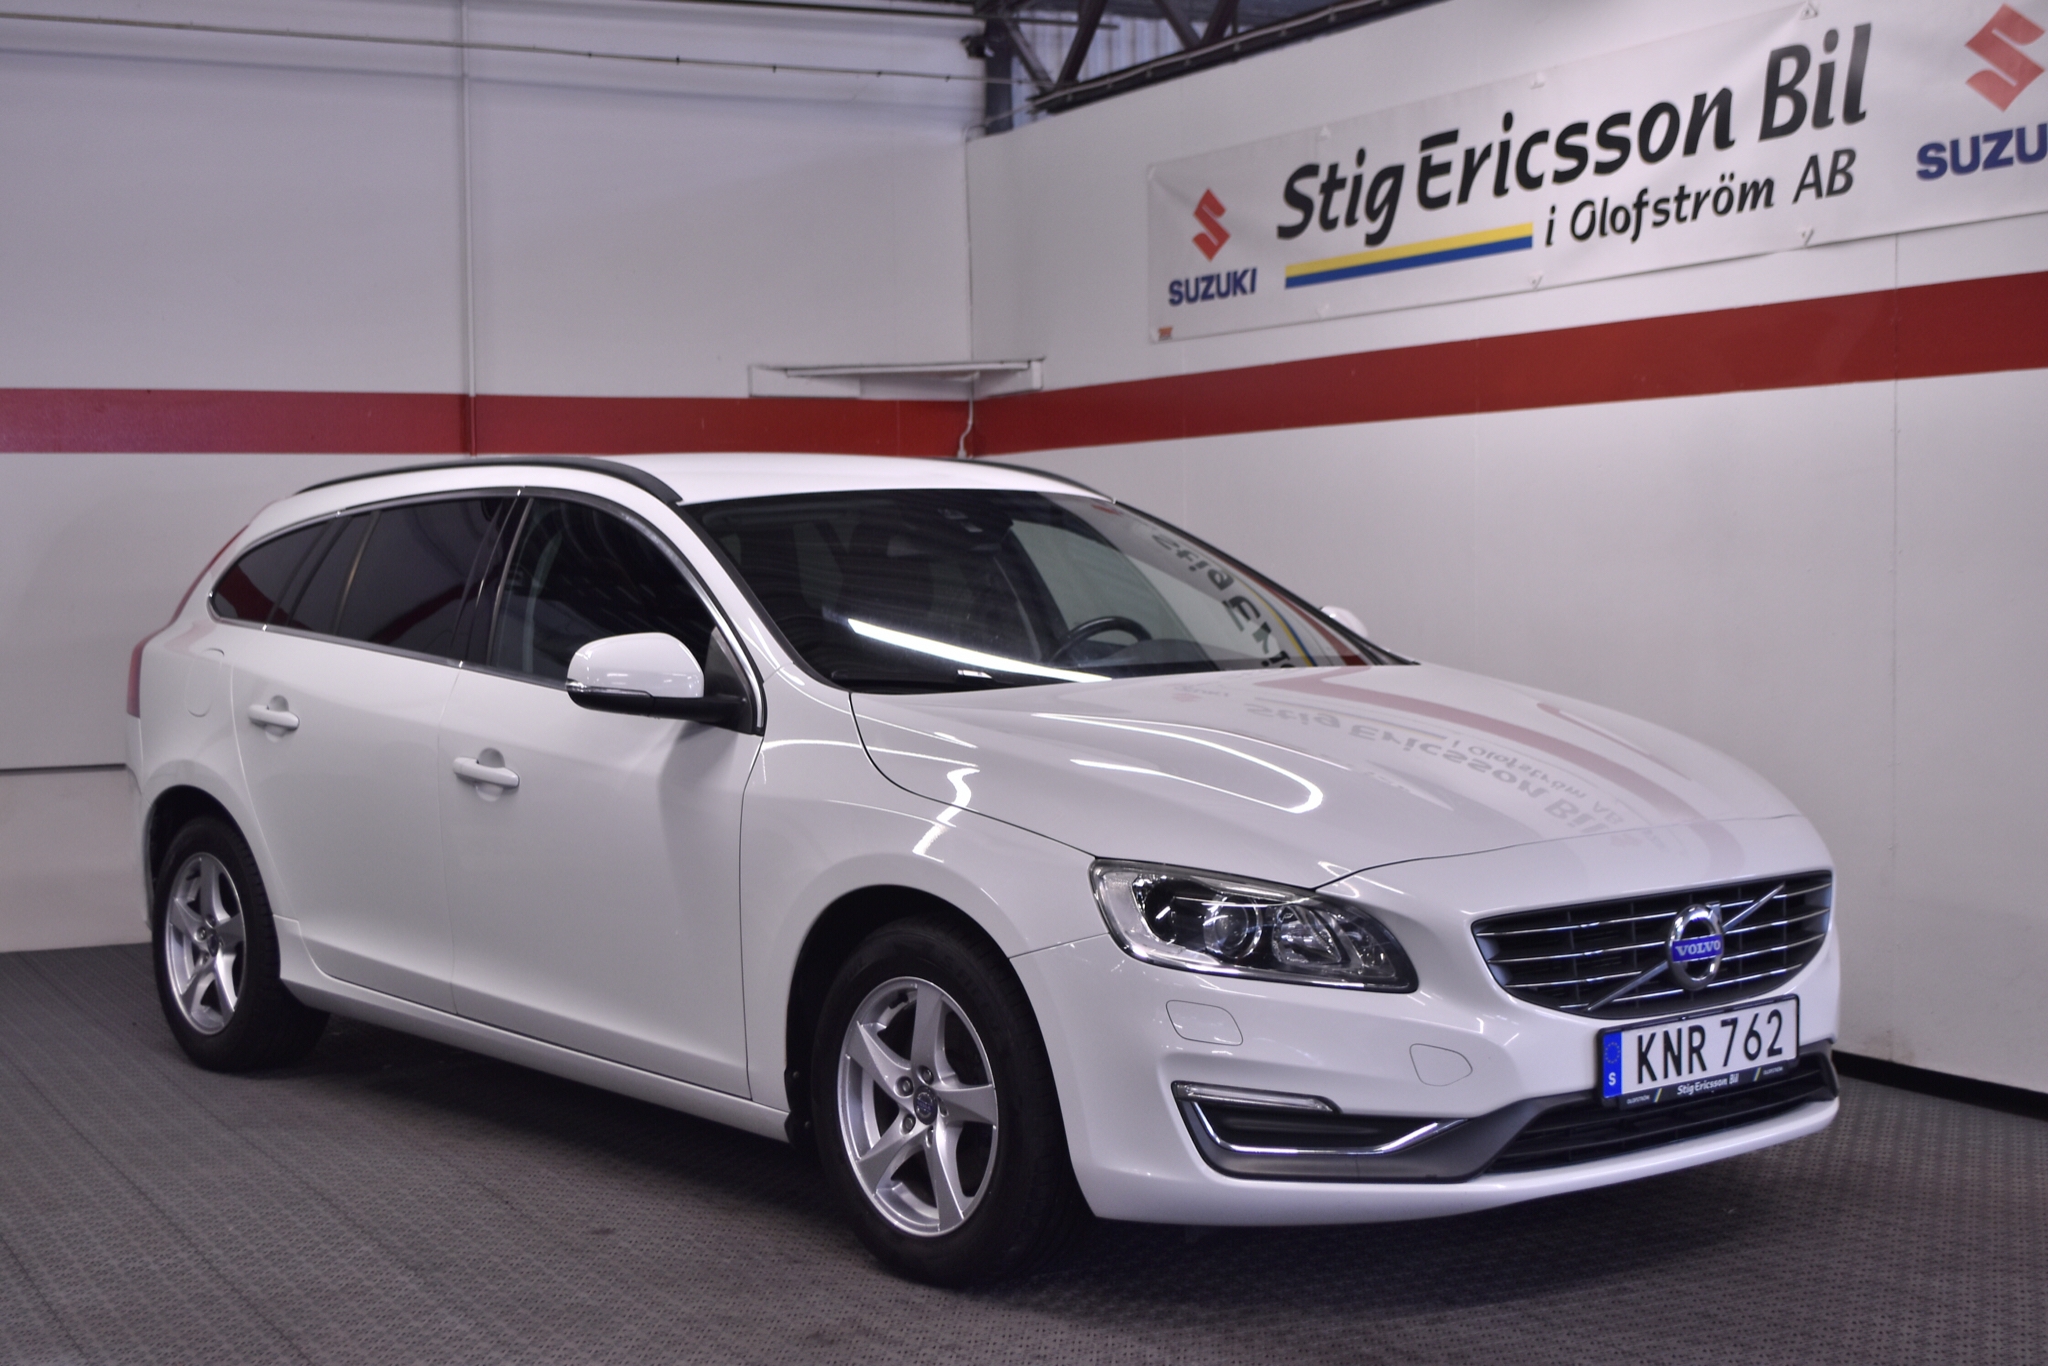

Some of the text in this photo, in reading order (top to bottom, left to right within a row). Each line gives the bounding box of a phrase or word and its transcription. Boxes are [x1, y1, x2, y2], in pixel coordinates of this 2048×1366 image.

[1277, 23, 1872, 248] Stig Ericsson Bil
[1545, 148, 1857, 248] i Olofström AB
[1168, 267, 1258, 307] SUZUKI
[1674, 938, 1722, 957] VOLVO
[1636, 1008, 1784, 1085] KNR 762
[1608, 1072, 1617, 1086] S
[1729, 1072, 1740, 1085] Bil
